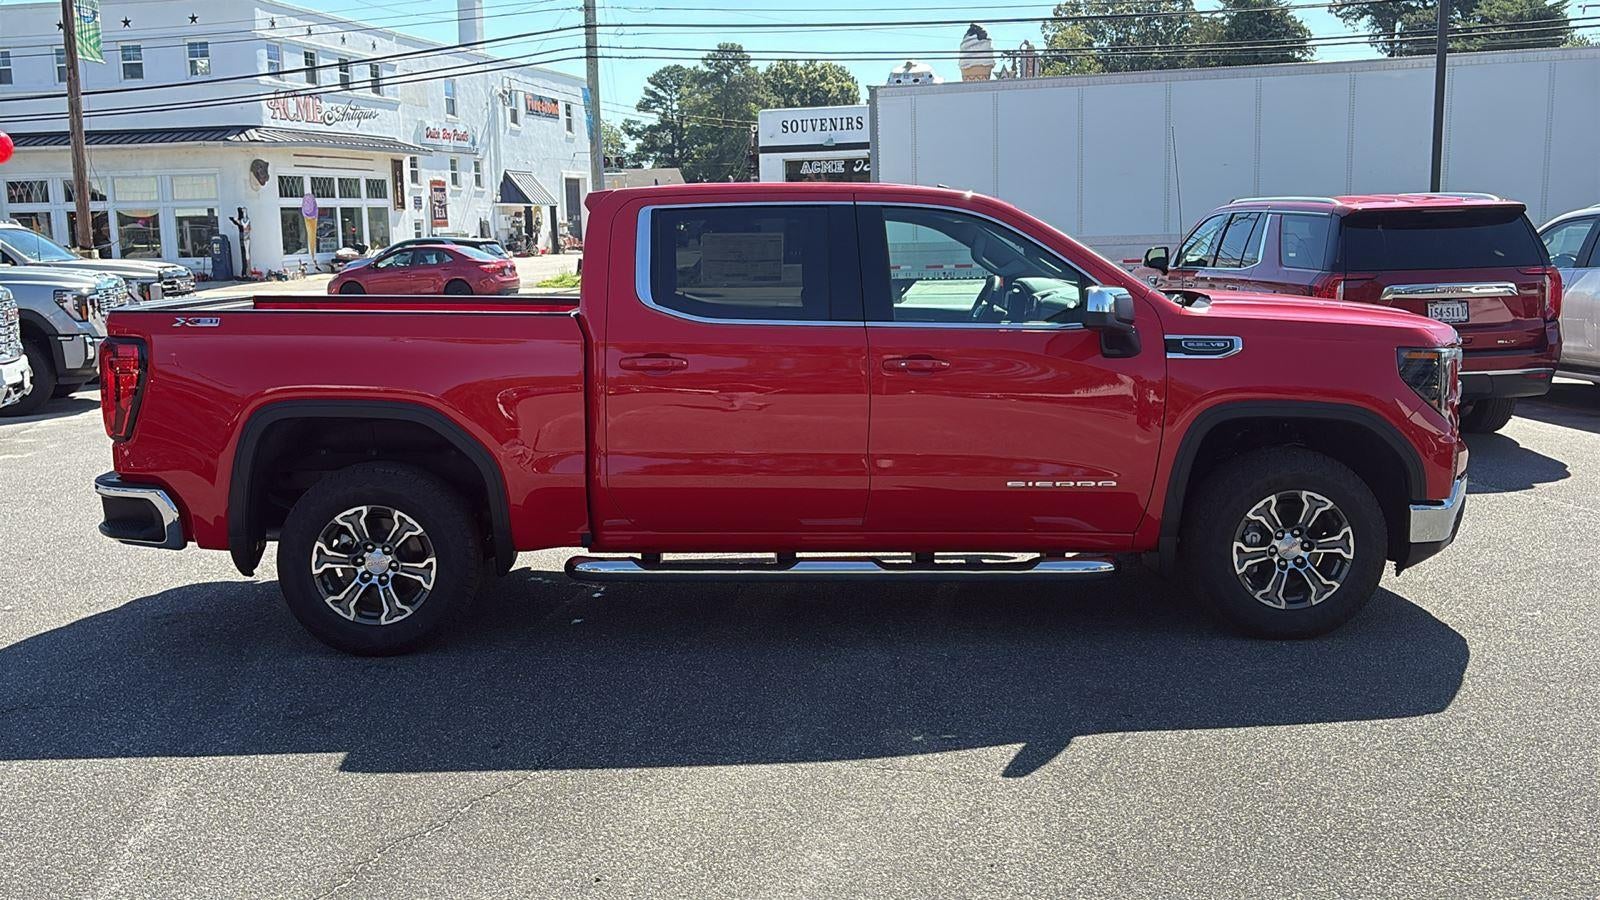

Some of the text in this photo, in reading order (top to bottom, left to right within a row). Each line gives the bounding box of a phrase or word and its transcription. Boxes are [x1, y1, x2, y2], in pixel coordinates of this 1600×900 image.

[267, 89, 324, 124] ACME
[781, 116, 864, 134] SOUVENIRS
[442, 128, 452, 143] Boy
[800, 160, 845, 174] ACME
